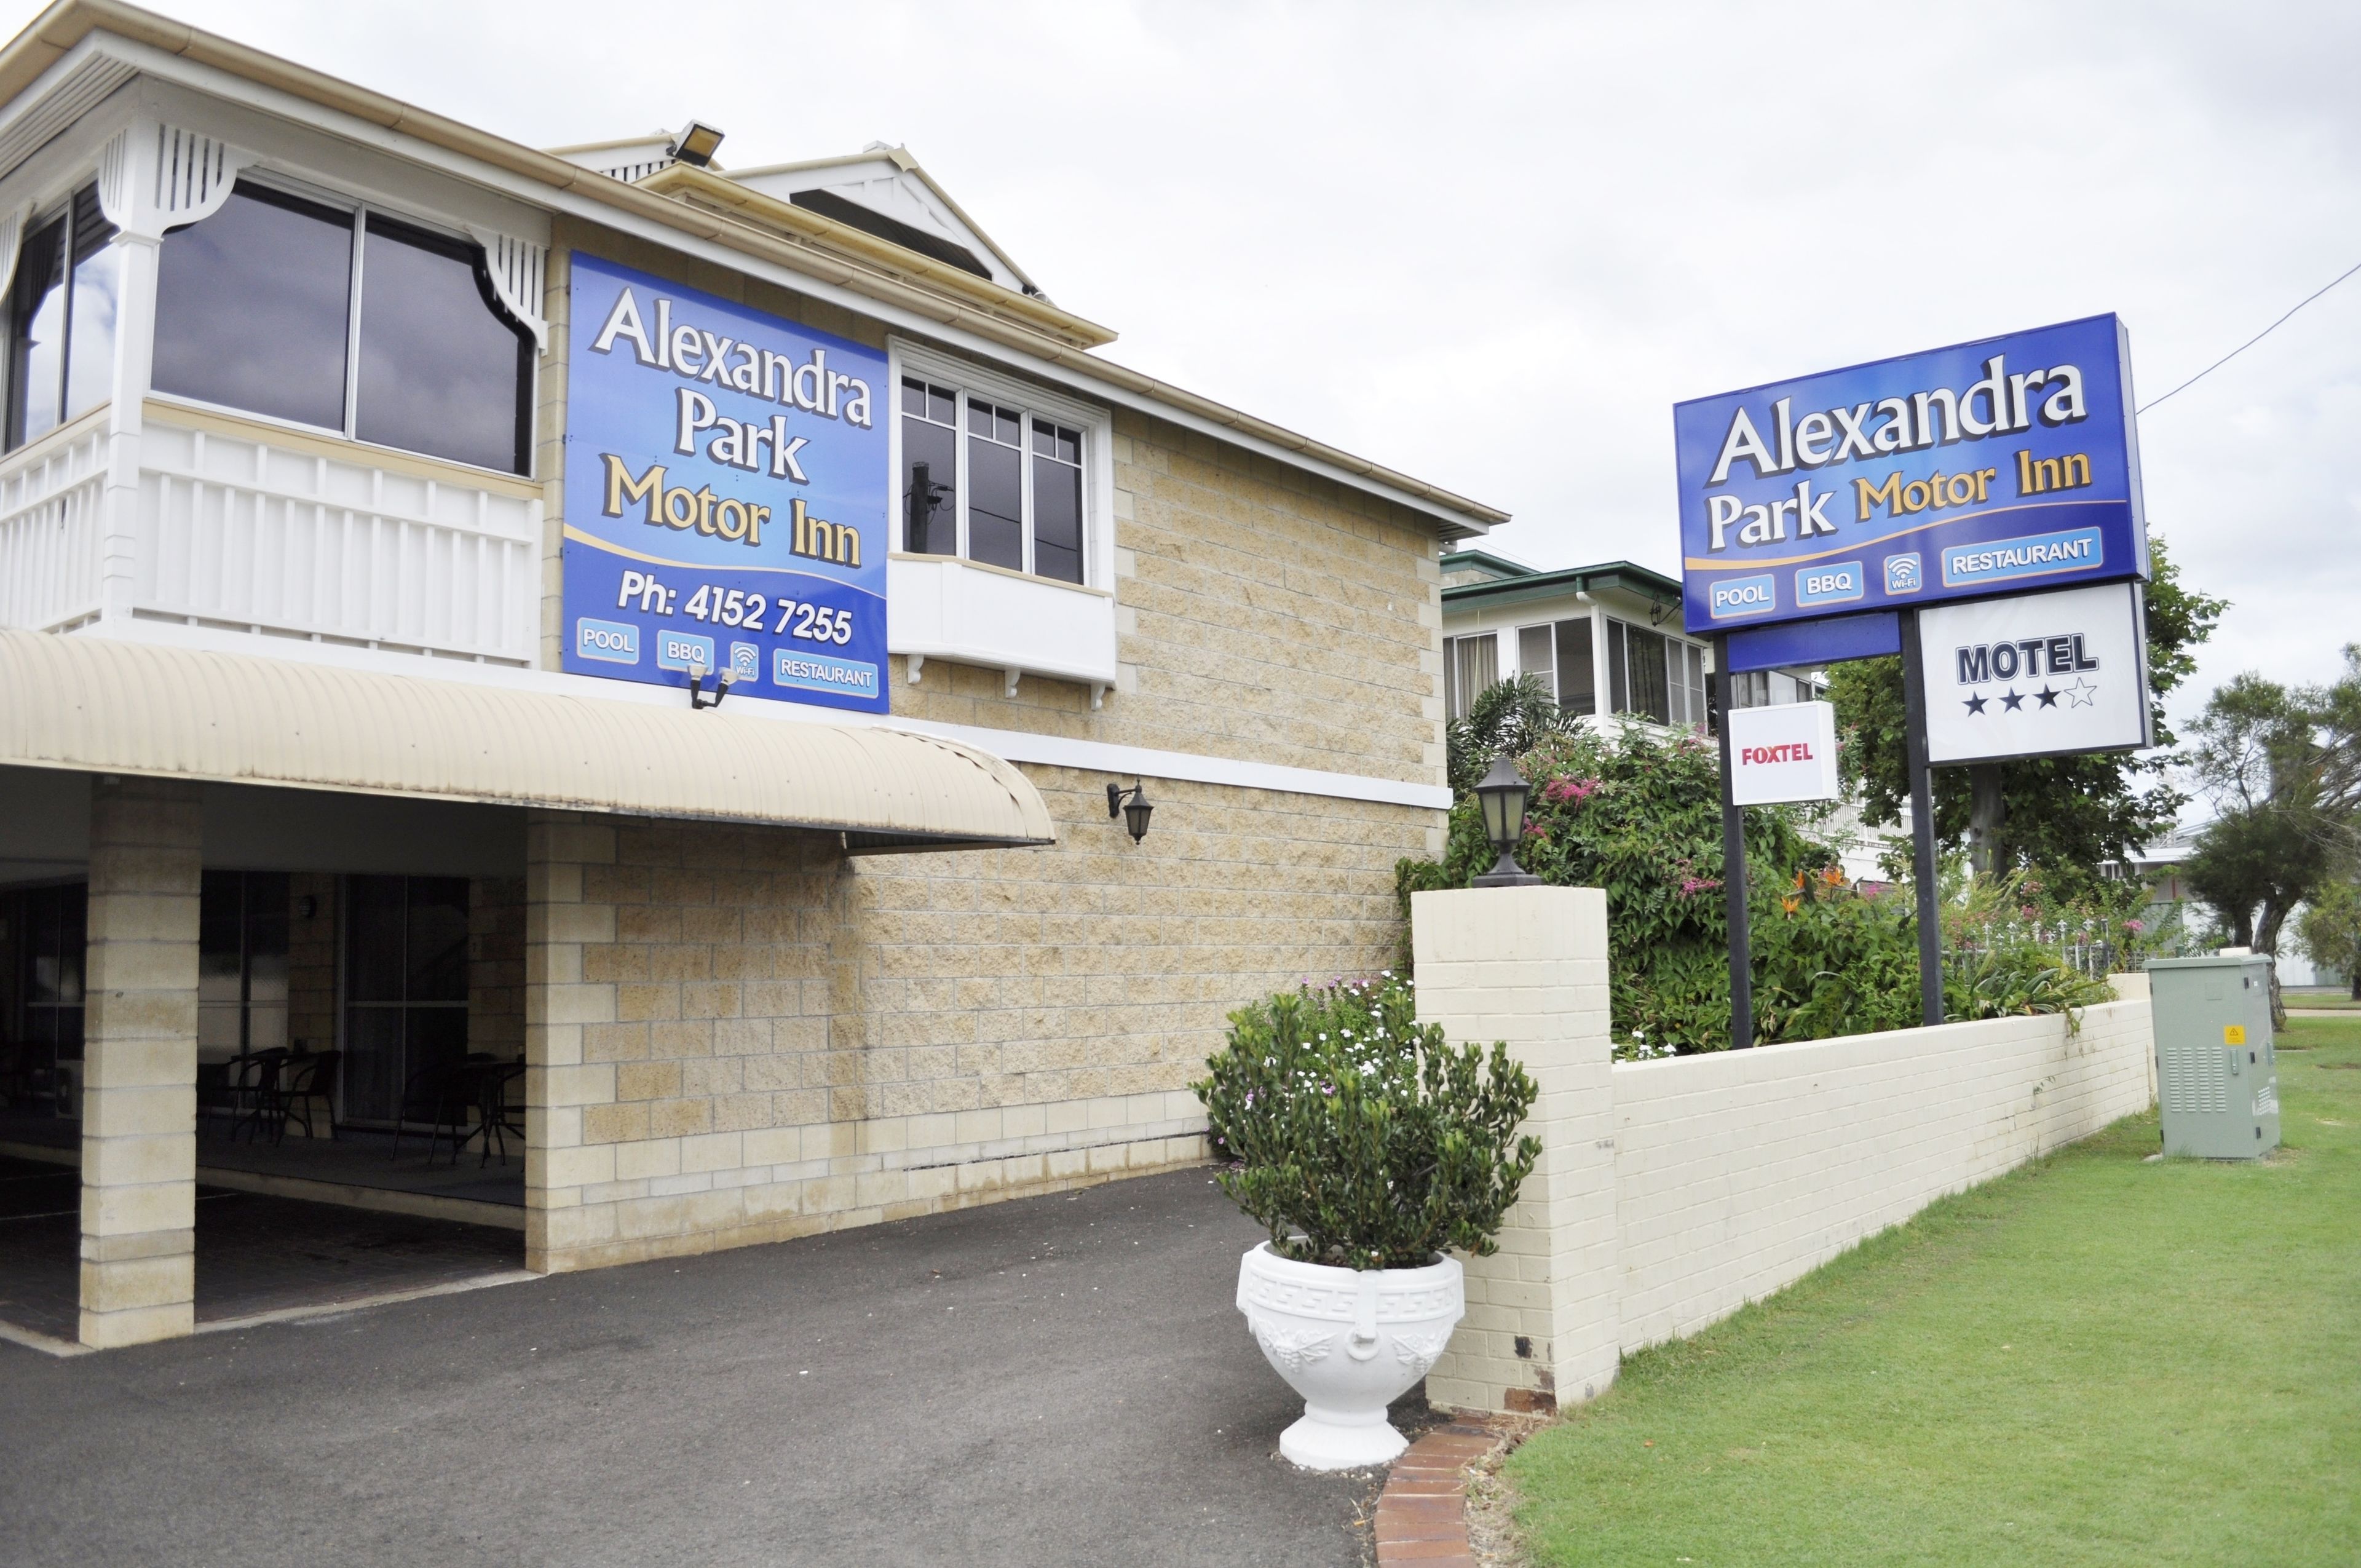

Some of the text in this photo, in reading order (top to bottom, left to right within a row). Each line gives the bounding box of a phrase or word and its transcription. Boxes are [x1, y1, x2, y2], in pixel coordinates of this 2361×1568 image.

[590, 286, 872, 429] Alexandra
[676, 386, 810, 486] Park
[1707, 354, 2087, 488] Alexandra
[599, 453, 861, 568] Motor Inn
[1707, 449, 2092, 553] Park Motor Inn
[1952, 538, 2093, 575] RESTAURANT
[1714, 584, 1771, 608] POOL
[1806, 572, 1853, 595] BBQ
[1891, 576, 1917, 590] Wi-Fi
[617, 569, 853, 646] Ph: 4152 7255
[582, 627, 636, 654] POOL
[666, 640, 706, 665] BBQ
[736, 665, 755, 676] Wi-Fi
[780, 658, 873, 689] RESTAURANT
[1956, 633, 2098, 685] MOTEL
[1742, 743, 1814, 766] FOXTEL
